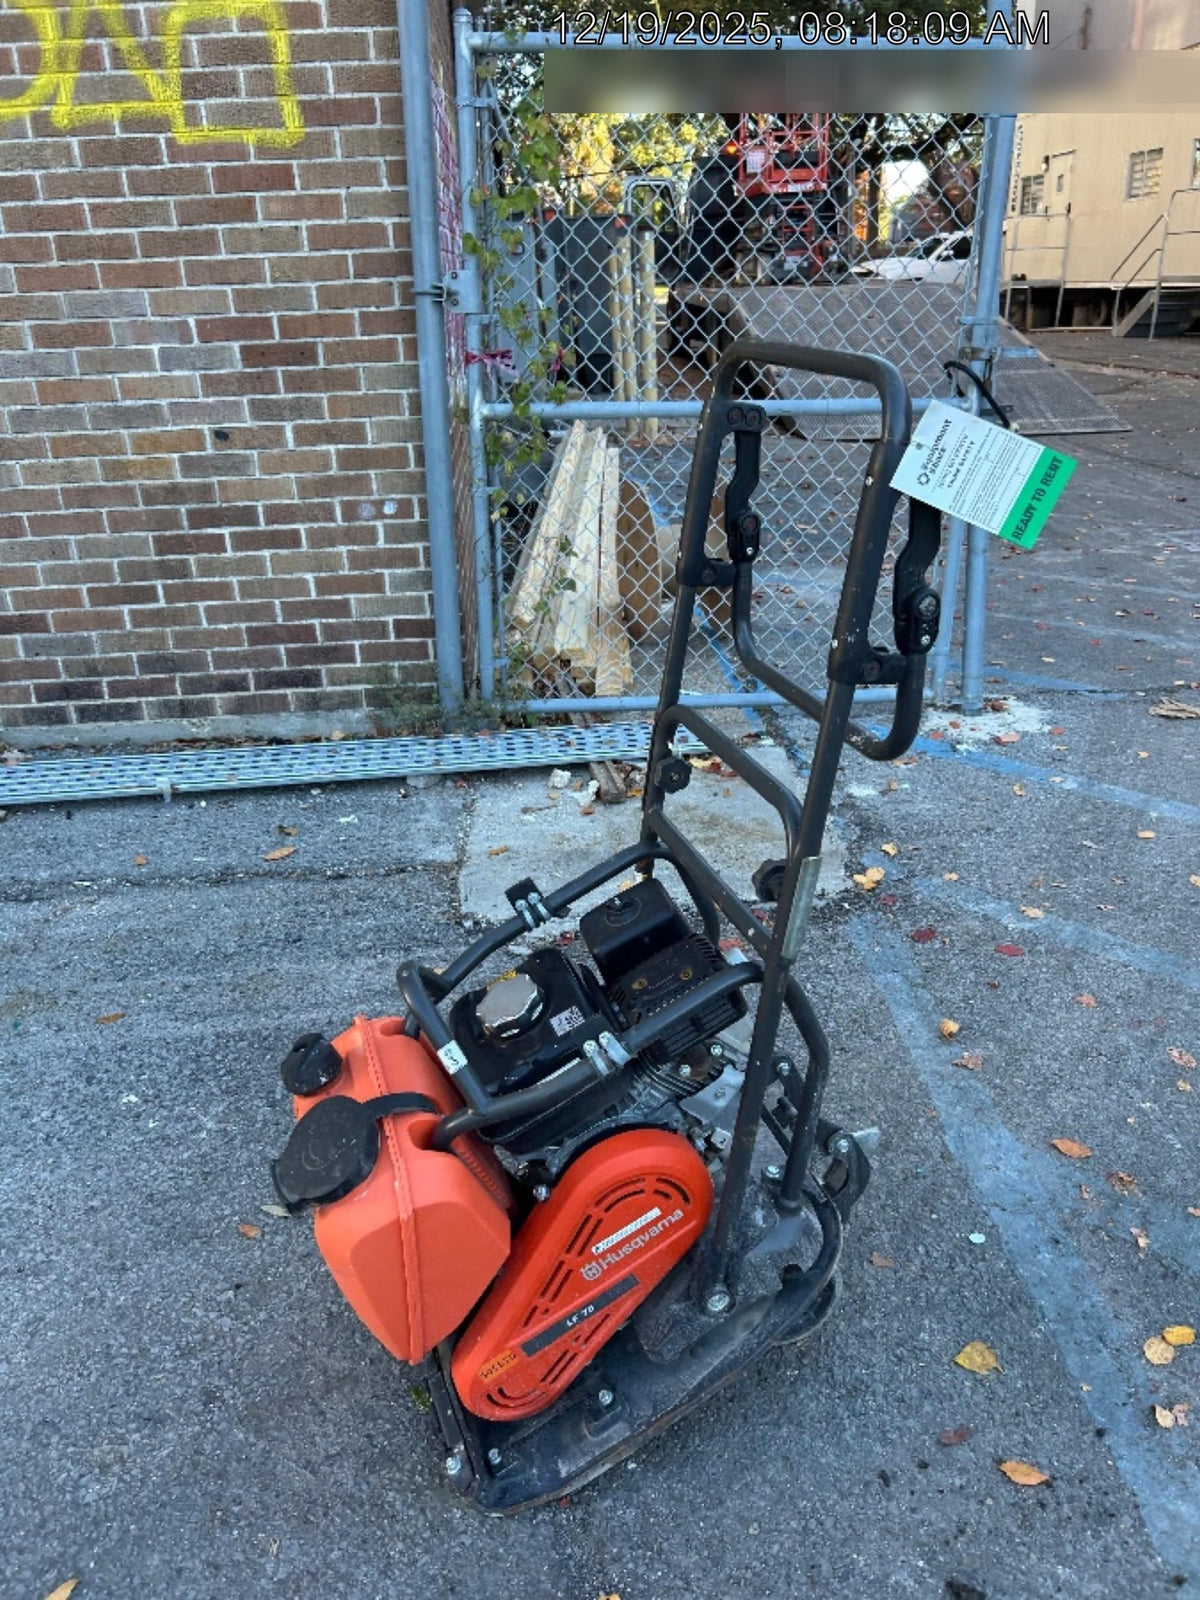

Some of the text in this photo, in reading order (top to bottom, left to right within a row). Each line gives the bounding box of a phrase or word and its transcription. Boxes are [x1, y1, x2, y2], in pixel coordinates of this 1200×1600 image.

[1012, 455, 1064, 540] READY TO RENT
[598, 1208, 684, 1270] Husqvarna
[566, 1304, 595, 1327] LF 70
